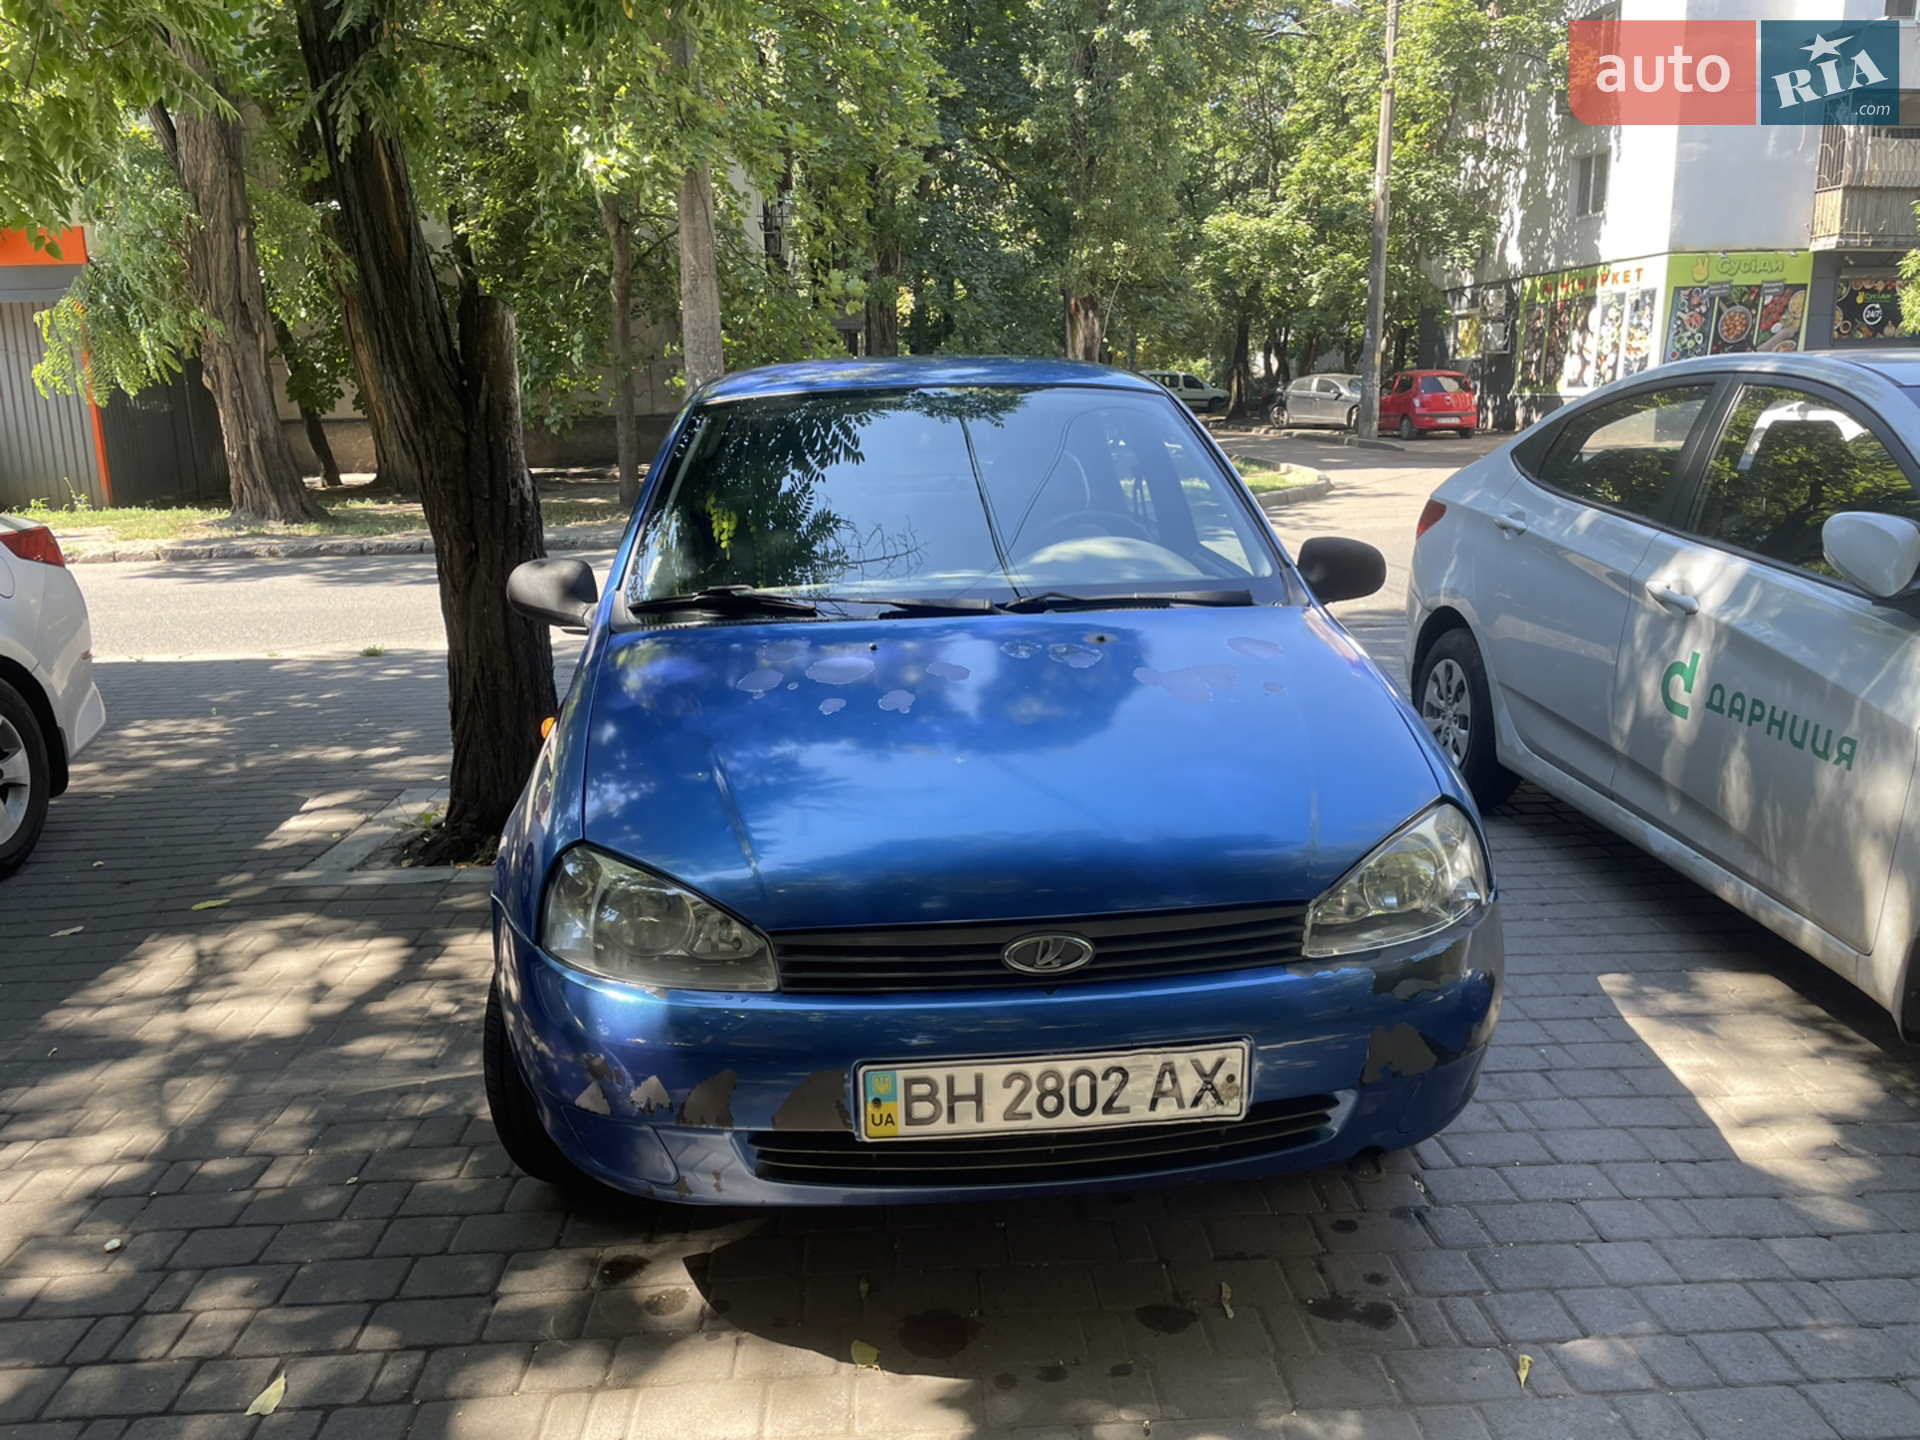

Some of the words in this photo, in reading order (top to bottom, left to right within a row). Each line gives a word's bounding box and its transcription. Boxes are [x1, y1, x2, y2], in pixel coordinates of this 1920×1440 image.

[1716, 256, 1784, 276] Сусіди
[1705, 683, 1858, 772] ДАРНИЦЯ
[903, 1072, 985, 1127] BH
[1002, 1066, 1130, 1121] 2802
[1148, 1056, 1228, 1112] AX
[871, 1113, 896, 1127] UA
